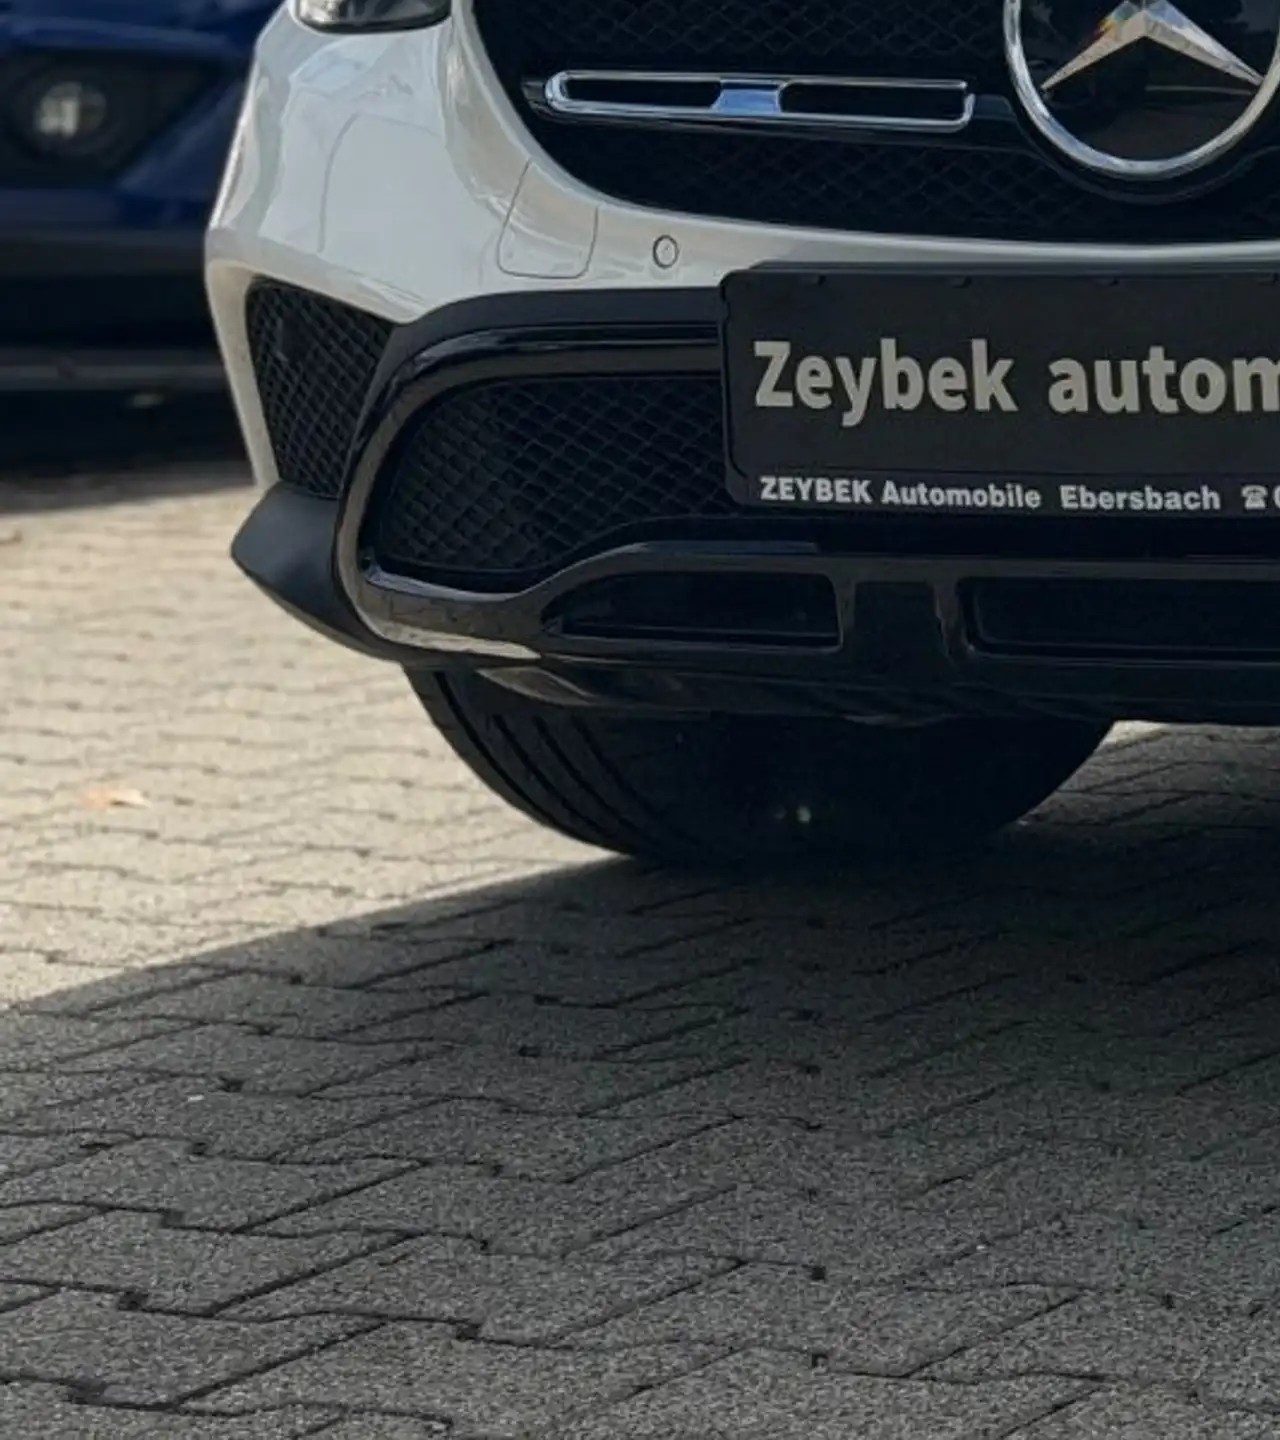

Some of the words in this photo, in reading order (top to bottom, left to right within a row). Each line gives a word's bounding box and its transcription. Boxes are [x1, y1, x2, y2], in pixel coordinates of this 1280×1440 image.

[754, 337, 1018, 427] Zeybek
[759, 476, 873, 504] ZEYBEK
[880, 479, 1042, 509] Automobile
[1059, 484, 1221, 511] Ebersbach
